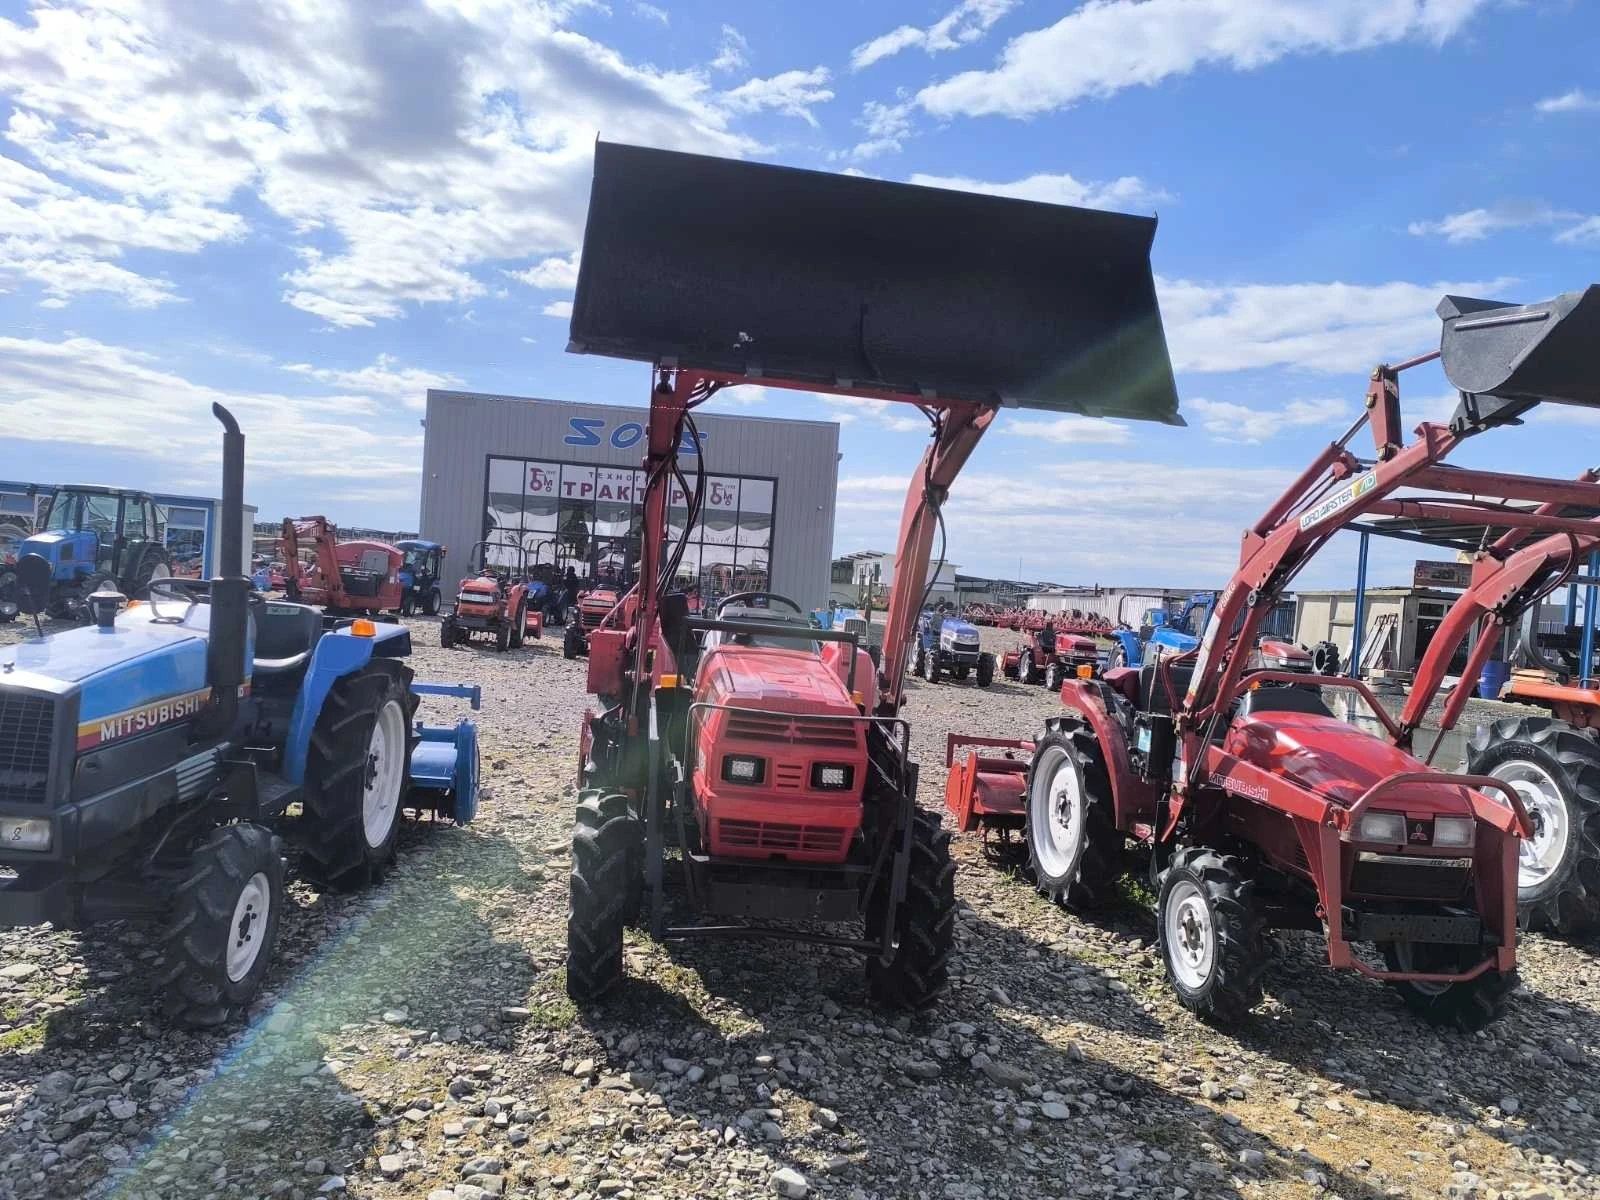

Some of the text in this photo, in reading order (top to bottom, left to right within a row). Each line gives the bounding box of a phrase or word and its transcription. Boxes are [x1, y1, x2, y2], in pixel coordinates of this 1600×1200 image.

[564, 417, 708, 454] SOS
[100, 697, 200, 742] MITSUBISHI
[1208, 771, 1270, 802] MITSUBISHI
